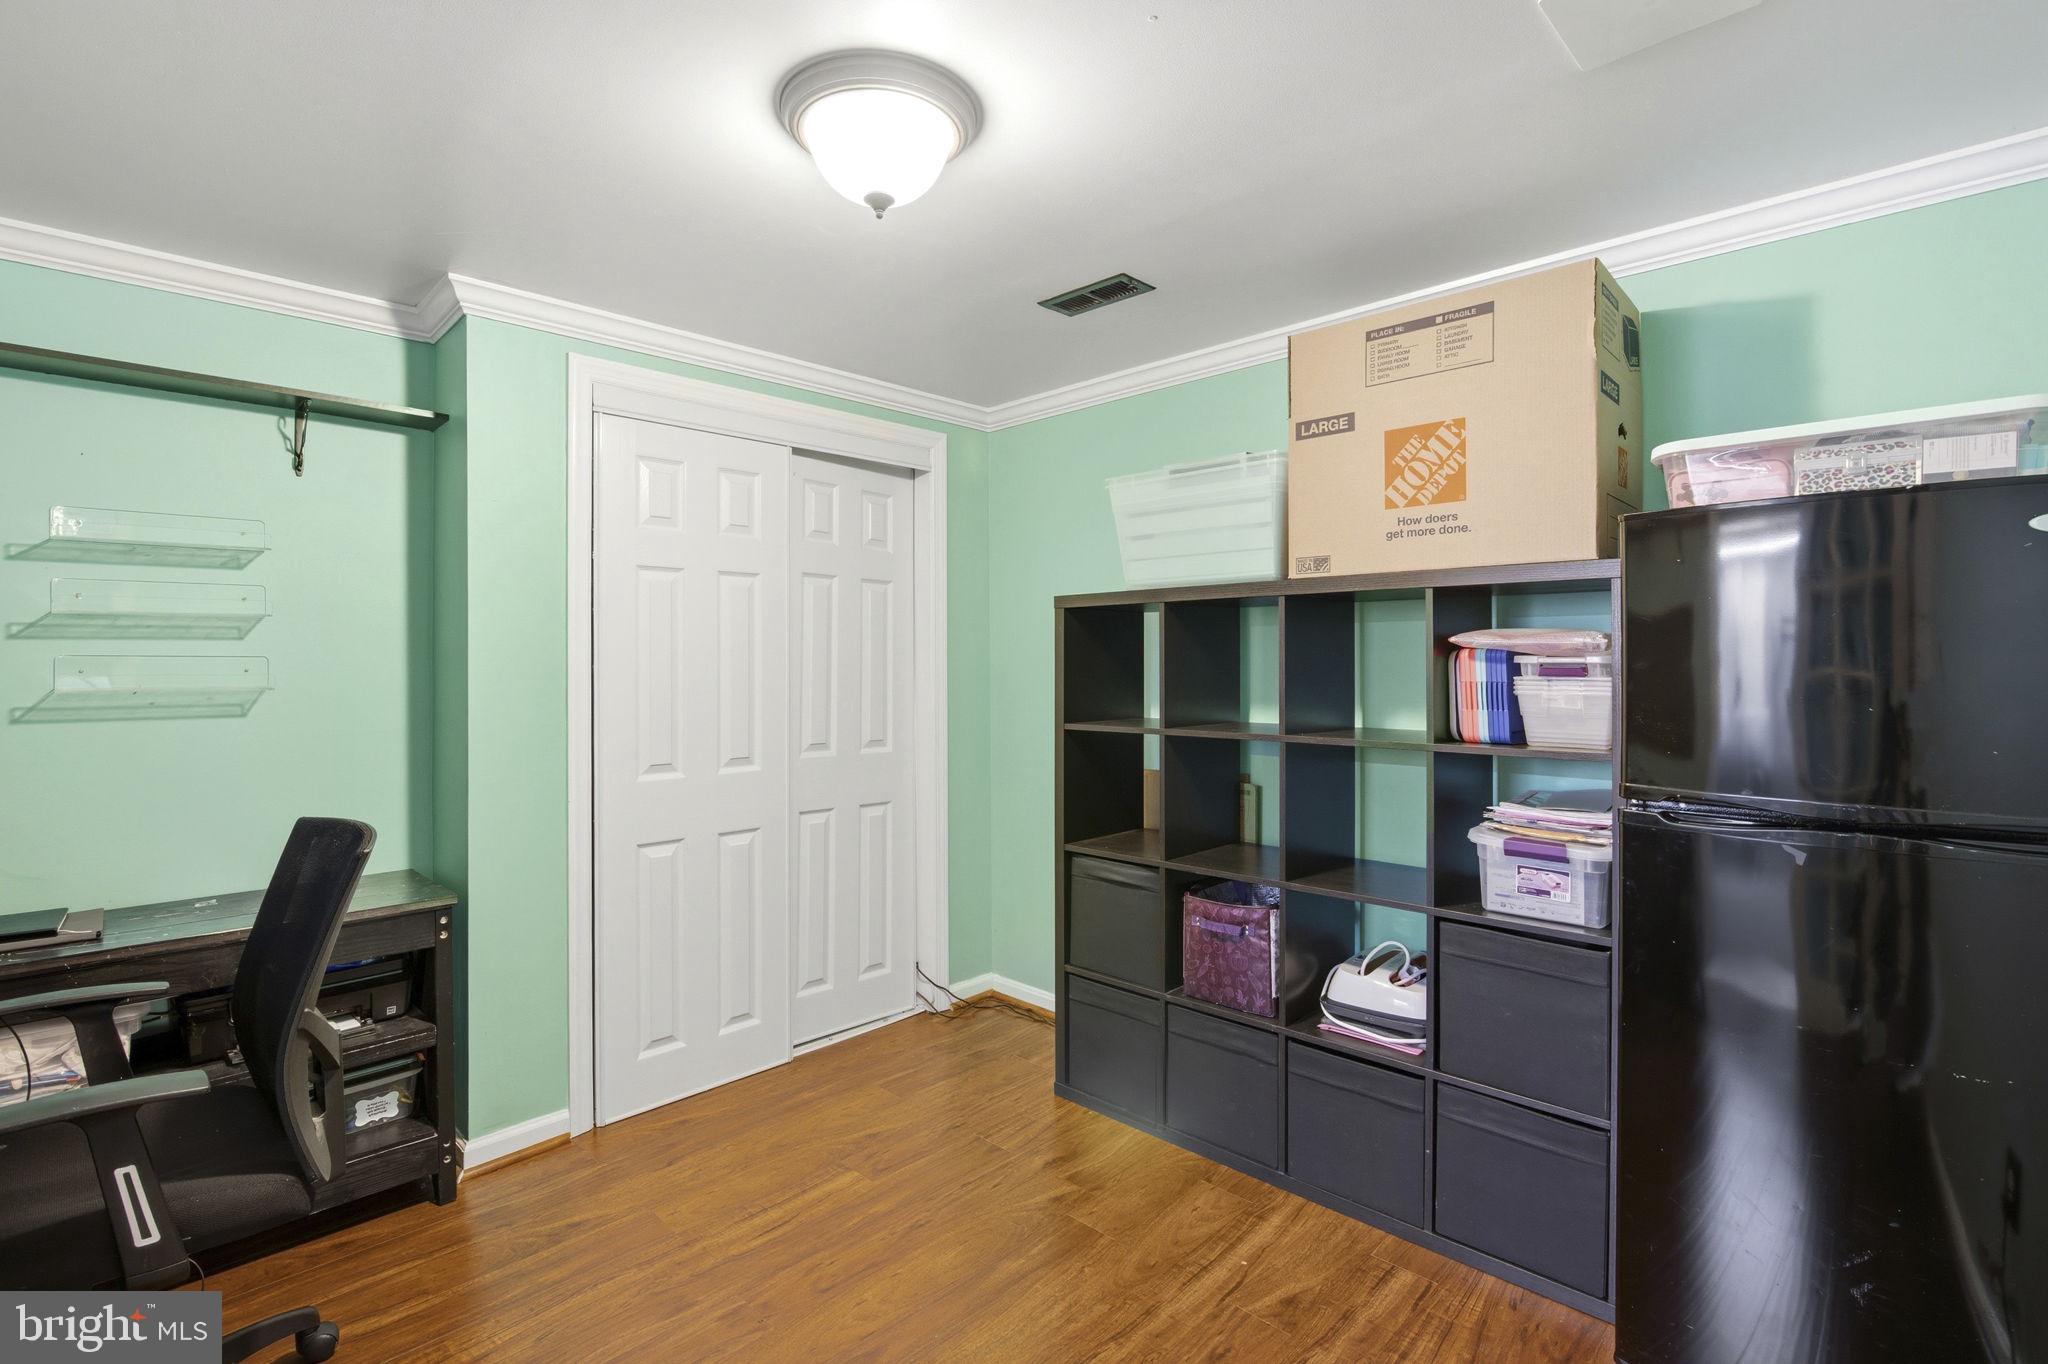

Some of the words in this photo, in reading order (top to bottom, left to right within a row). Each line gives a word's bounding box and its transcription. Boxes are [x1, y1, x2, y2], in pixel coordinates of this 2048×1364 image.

[1444, 308, 1477, 321] FRAGILE
[1370, 326, 1393, 339] PLACE
[1301, 416, 1349, 437] LARGE
[1392, 433, 1425, 468] THE
[1385, 419, 1466, 508] HOME
[1416, 449, 1466, 506] DEPOT
[1397, 516, 1422, 526] How
[1425, 513, 1458, 524] doers
[1386, 529, 1404, 541] get
[1407, 527, 1436, 537] more
[1439, 524, 1472, 535] done.
[1297, 563, 1312, 572] USA
